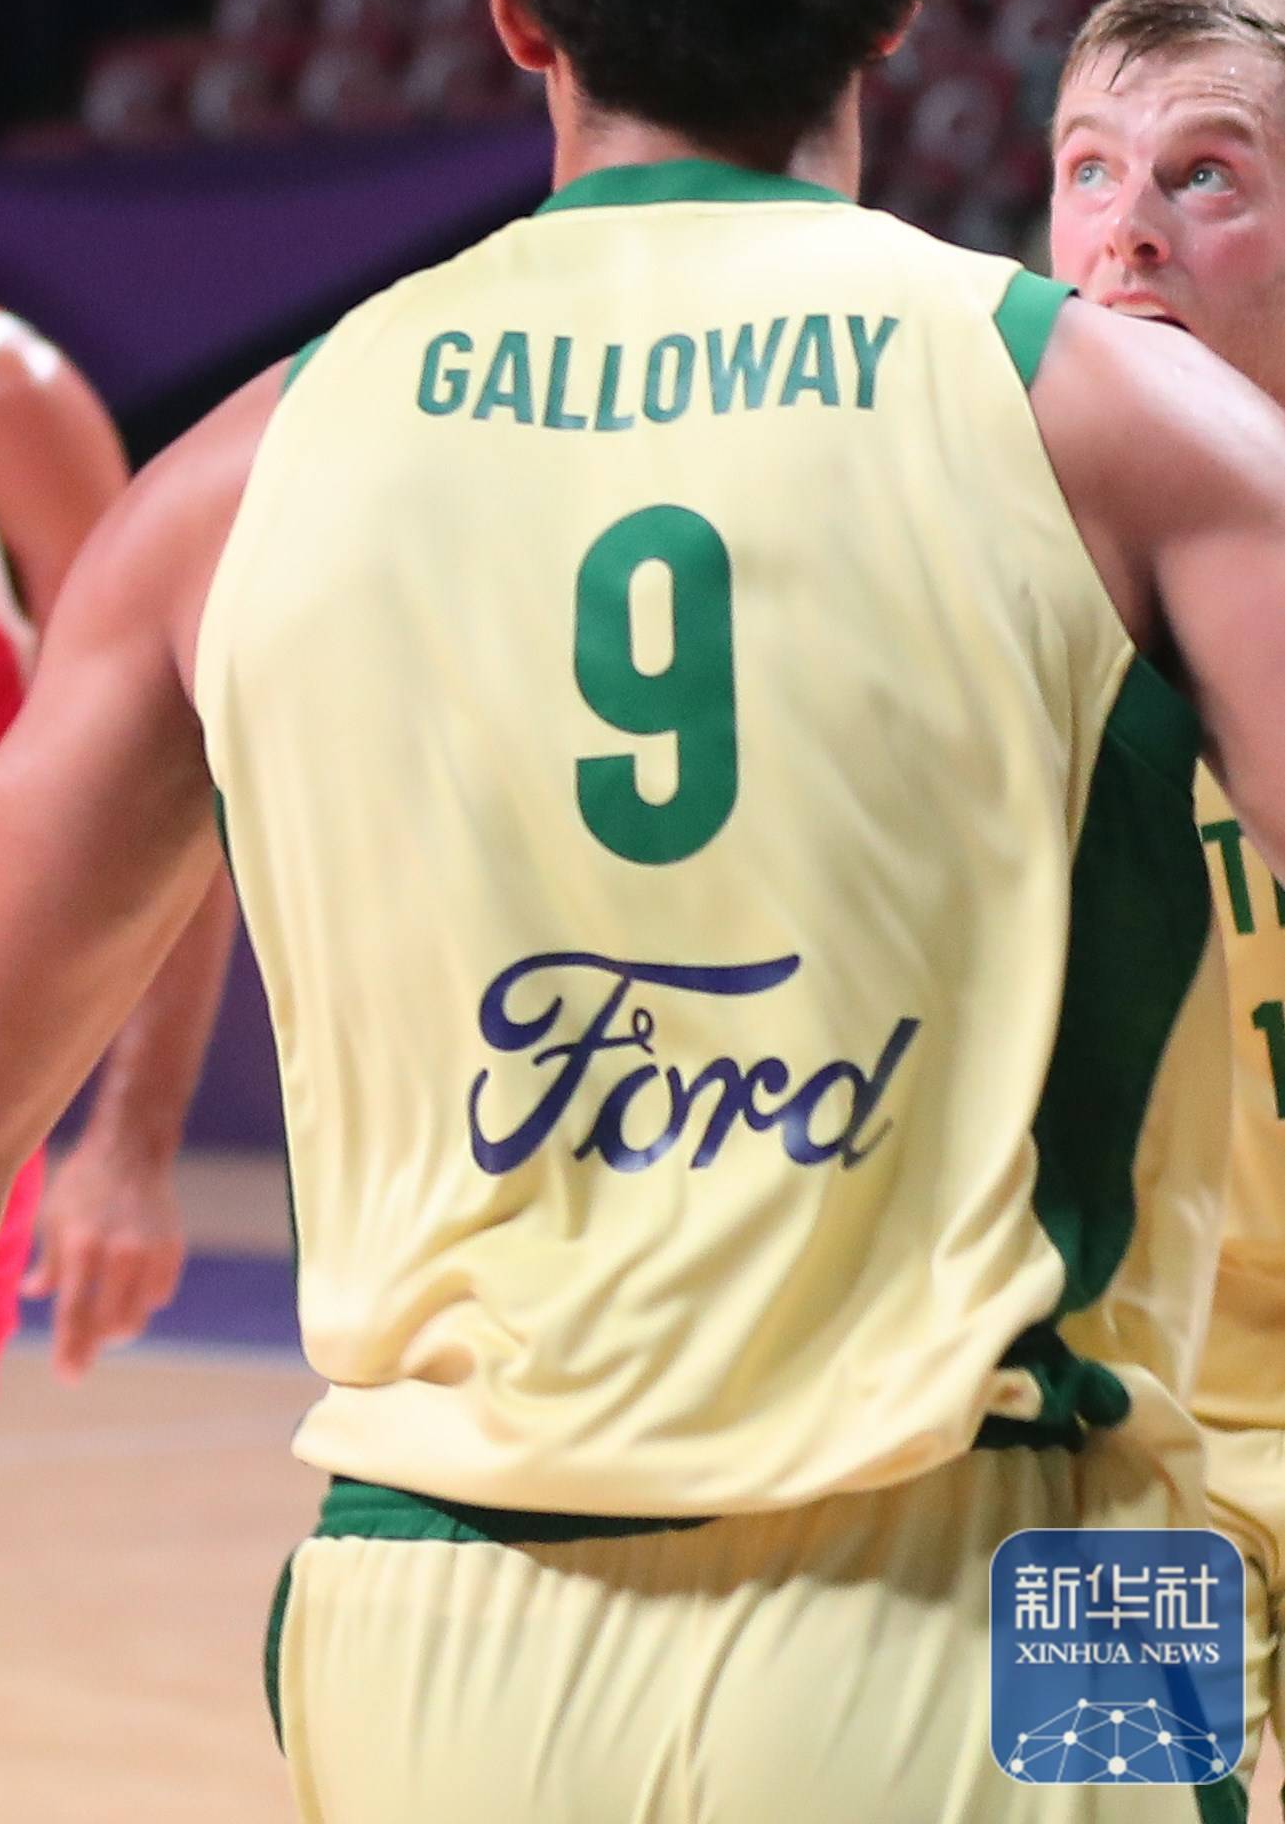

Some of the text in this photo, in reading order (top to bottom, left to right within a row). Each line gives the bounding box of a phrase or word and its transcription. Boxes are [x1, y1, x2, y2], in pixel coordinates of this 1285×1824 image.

[416, 314, 900, 432] GALLOWAY
[574, 504, 738, 866] 9
[468, 952, 921, 1176] Ford
